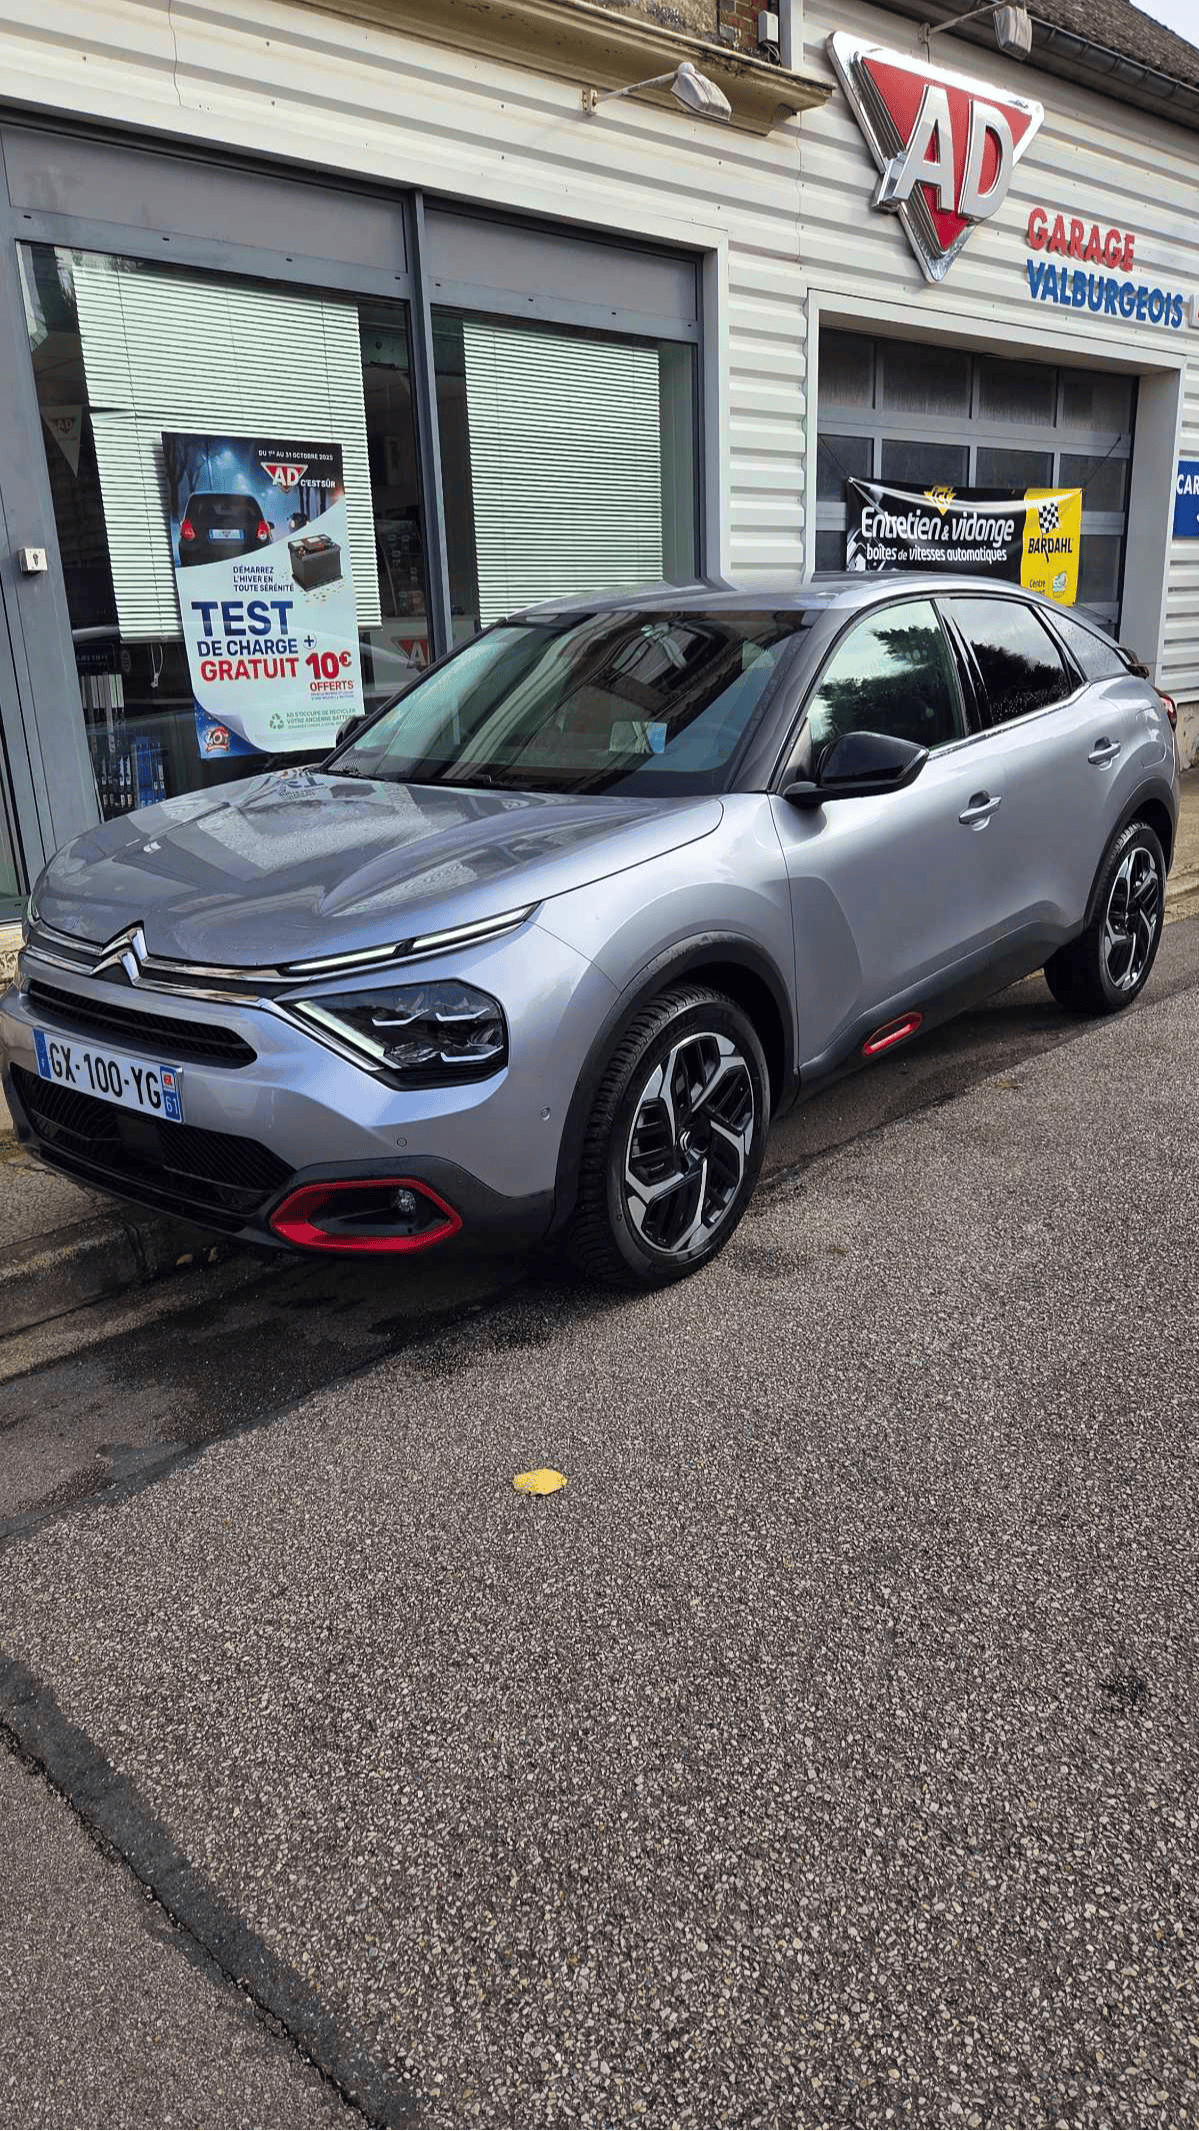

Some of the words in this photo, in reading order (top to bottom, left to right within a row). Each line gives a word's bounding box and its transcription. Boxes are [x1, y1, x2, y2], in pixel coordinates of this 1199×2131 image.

[882, 84, 1014, 220] AD
[1027, 207, 1136, 272] GARAGE
[1026, 259, 1184, 328] VALBURGEOIS
[276, 450, 285, 458] AU
[292, 452, 318, 460] OCTOBRE
[272, 466, 299, 487] AD
[300, 479, 320, 488] C'EST
[321, 477, 336, 489] SÛR
[861, 506, 942, 541] Entretien
[941, 524, 950, 541] &
[952, 510, 1015, 548] vidange
[866, 543, 897, 560] boîtes
[897, 549, 908, 561] de
[909, 544, 946, 561] vitesses
[946, 545, 1008, 565] automatiques
[1028, 537, 1073, 555] BARDAHL
[232, 564, 274, 574] DÉMARREZ
[233, 575, 262, 583] L'HIVER
[263, 575, 274, 583] EN
[233, 584, 259, 592] TOUTE
[259, 581, 295, 592] SÉRÉNITÉ
[190, 600, 294, 637] TEST
[196, 640, 223, 657] DE
[226, 638, 299, 656] CHARGE
[200, 657, 299, 682] GRATUIT
[305, 650, 353, 680] 10€
[309, 680, 354, 692] OFFERTS
[49, 1042, 162, 1109] GX-100-YG
[165, 1096, 178, 1114] 61
